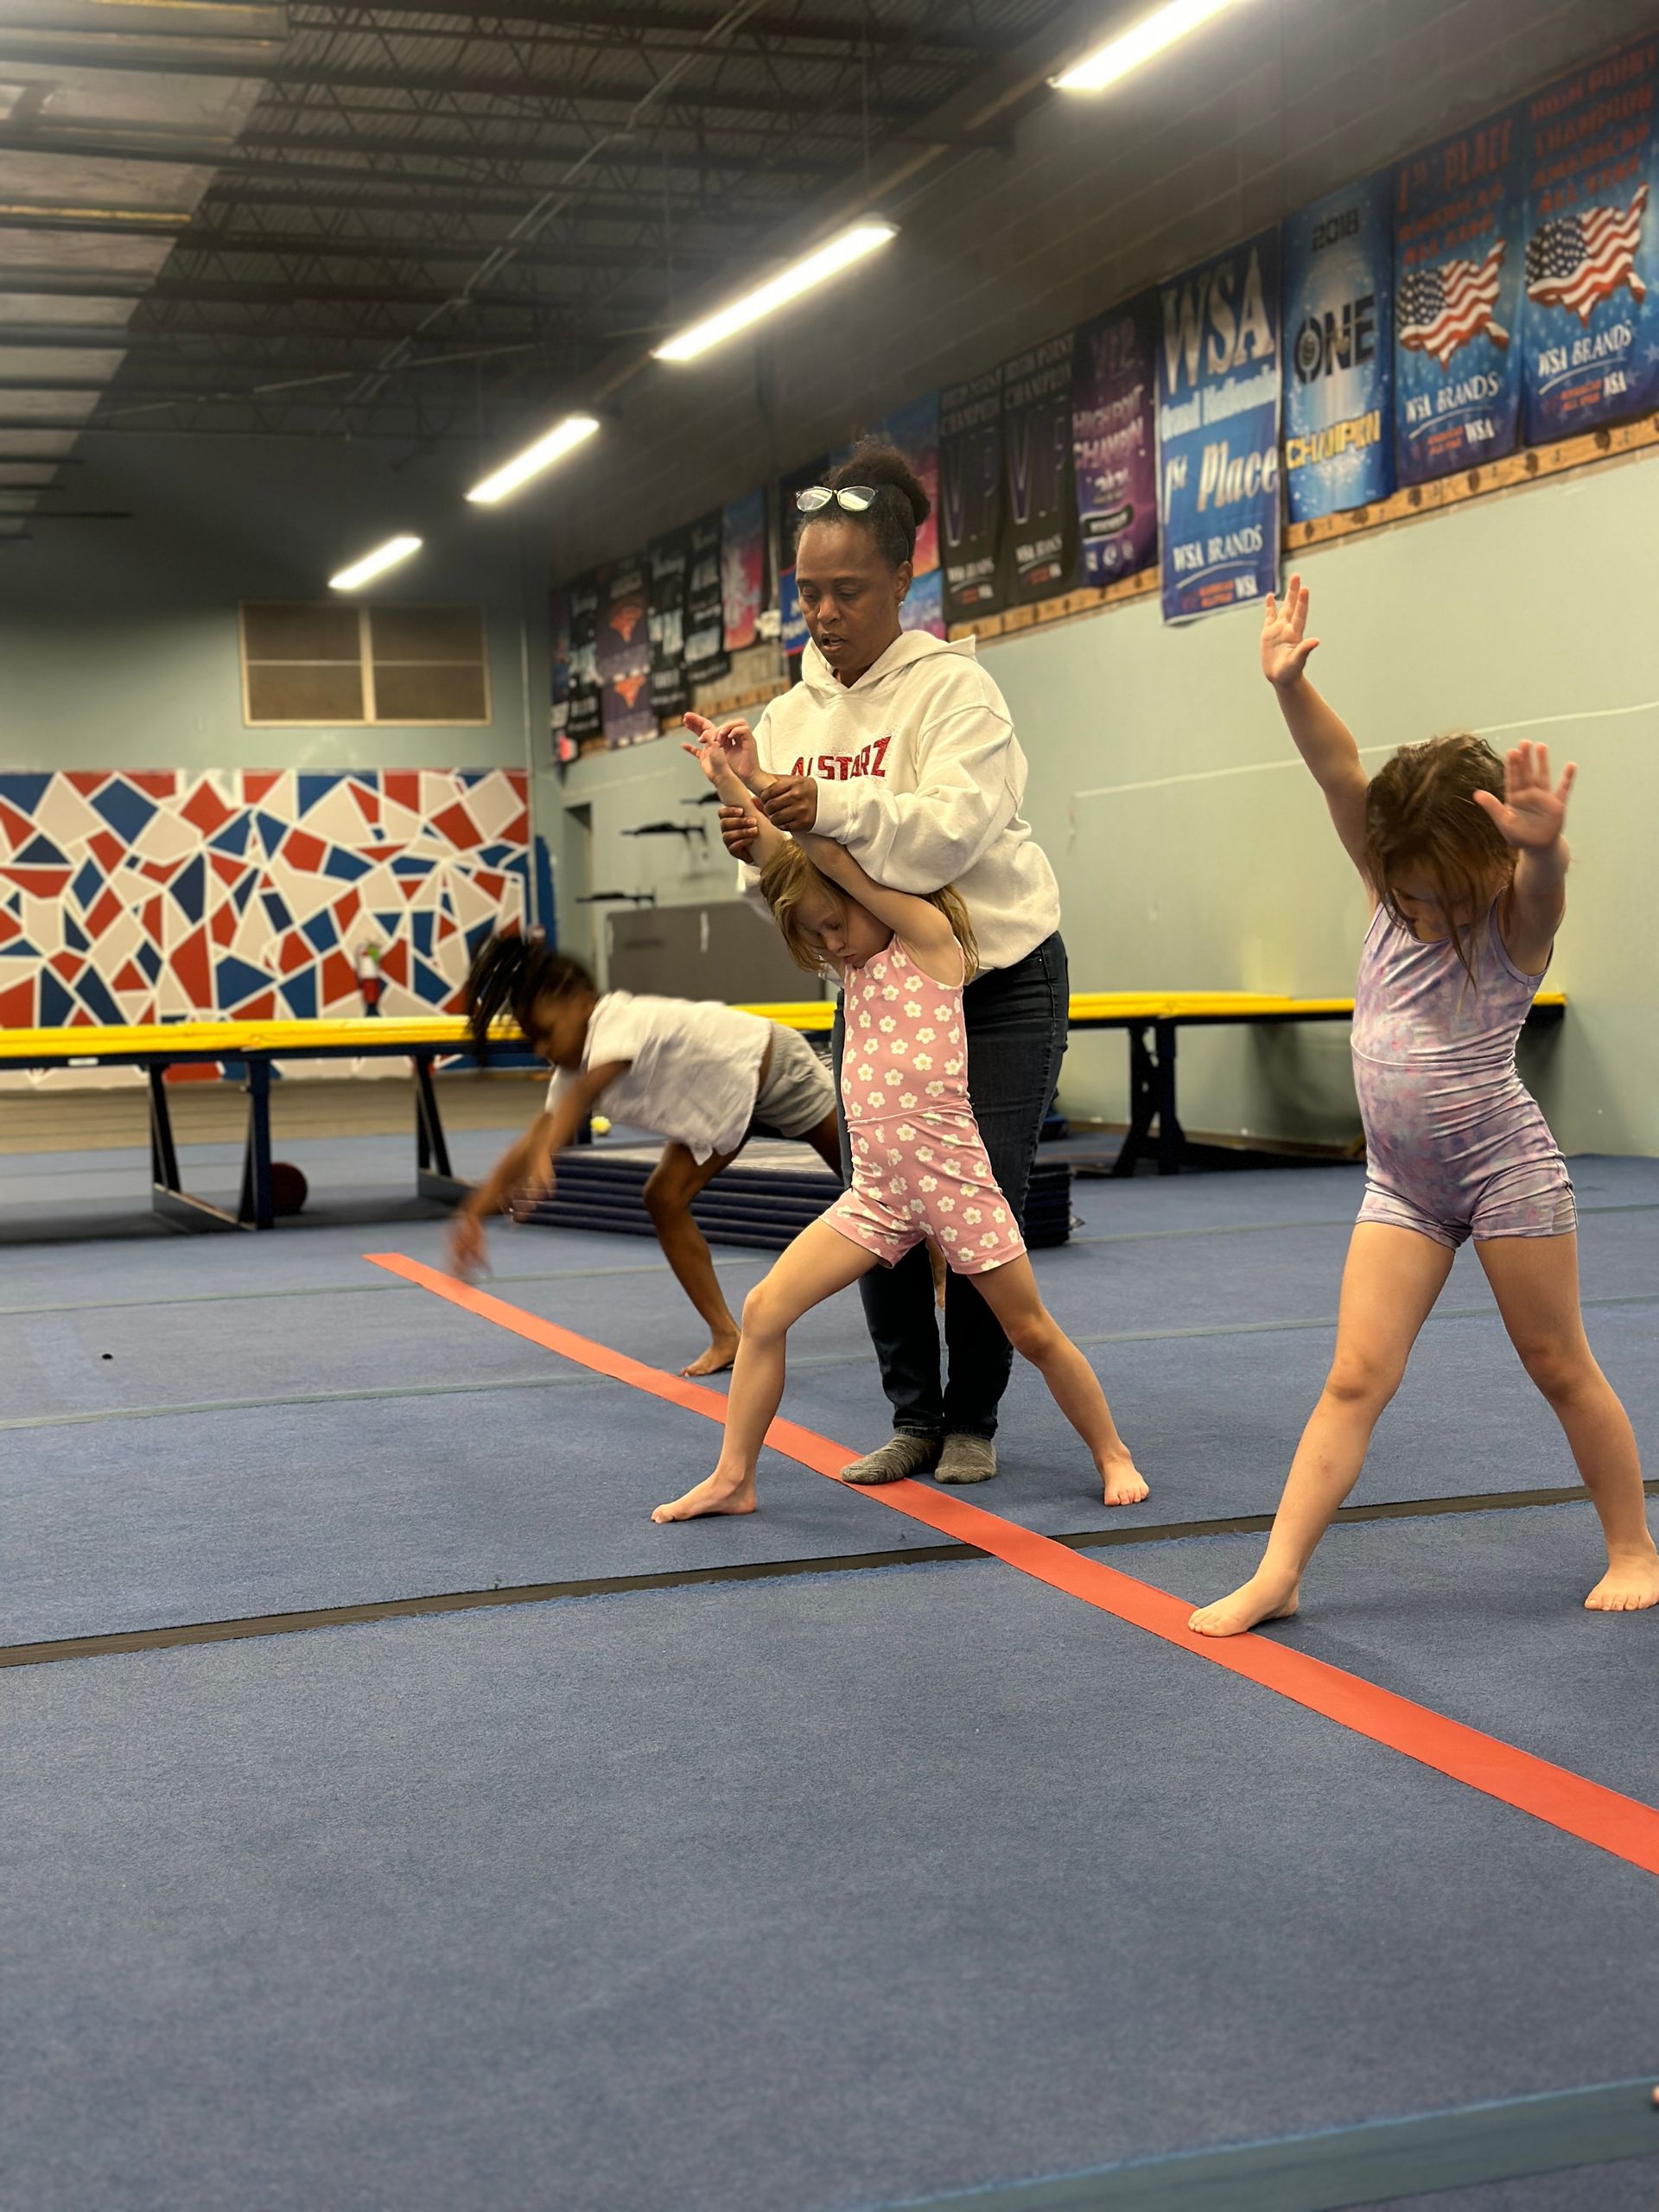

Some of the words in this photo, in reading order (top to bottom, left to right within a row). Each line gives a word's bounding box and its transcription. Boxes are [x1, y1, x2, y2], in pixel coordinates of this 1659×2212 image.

[1312, 209, 1360, 251] 2018
[1160, 246, 1275, 397] WSA
[1294, 294, 1376, 386] ONE
[1538, 347, 1568, 378] WSA
[1571, 319, 1633, 366] BRANDS
[1405, 393, 1433, 423] WSA
[1436, 371, 1500, 414] BRANDS
[1197, 440, 1279, 512] Place
[1173, 541, 1205, 572] WSA
[1207, 523, 1264, 563] BRANDS
